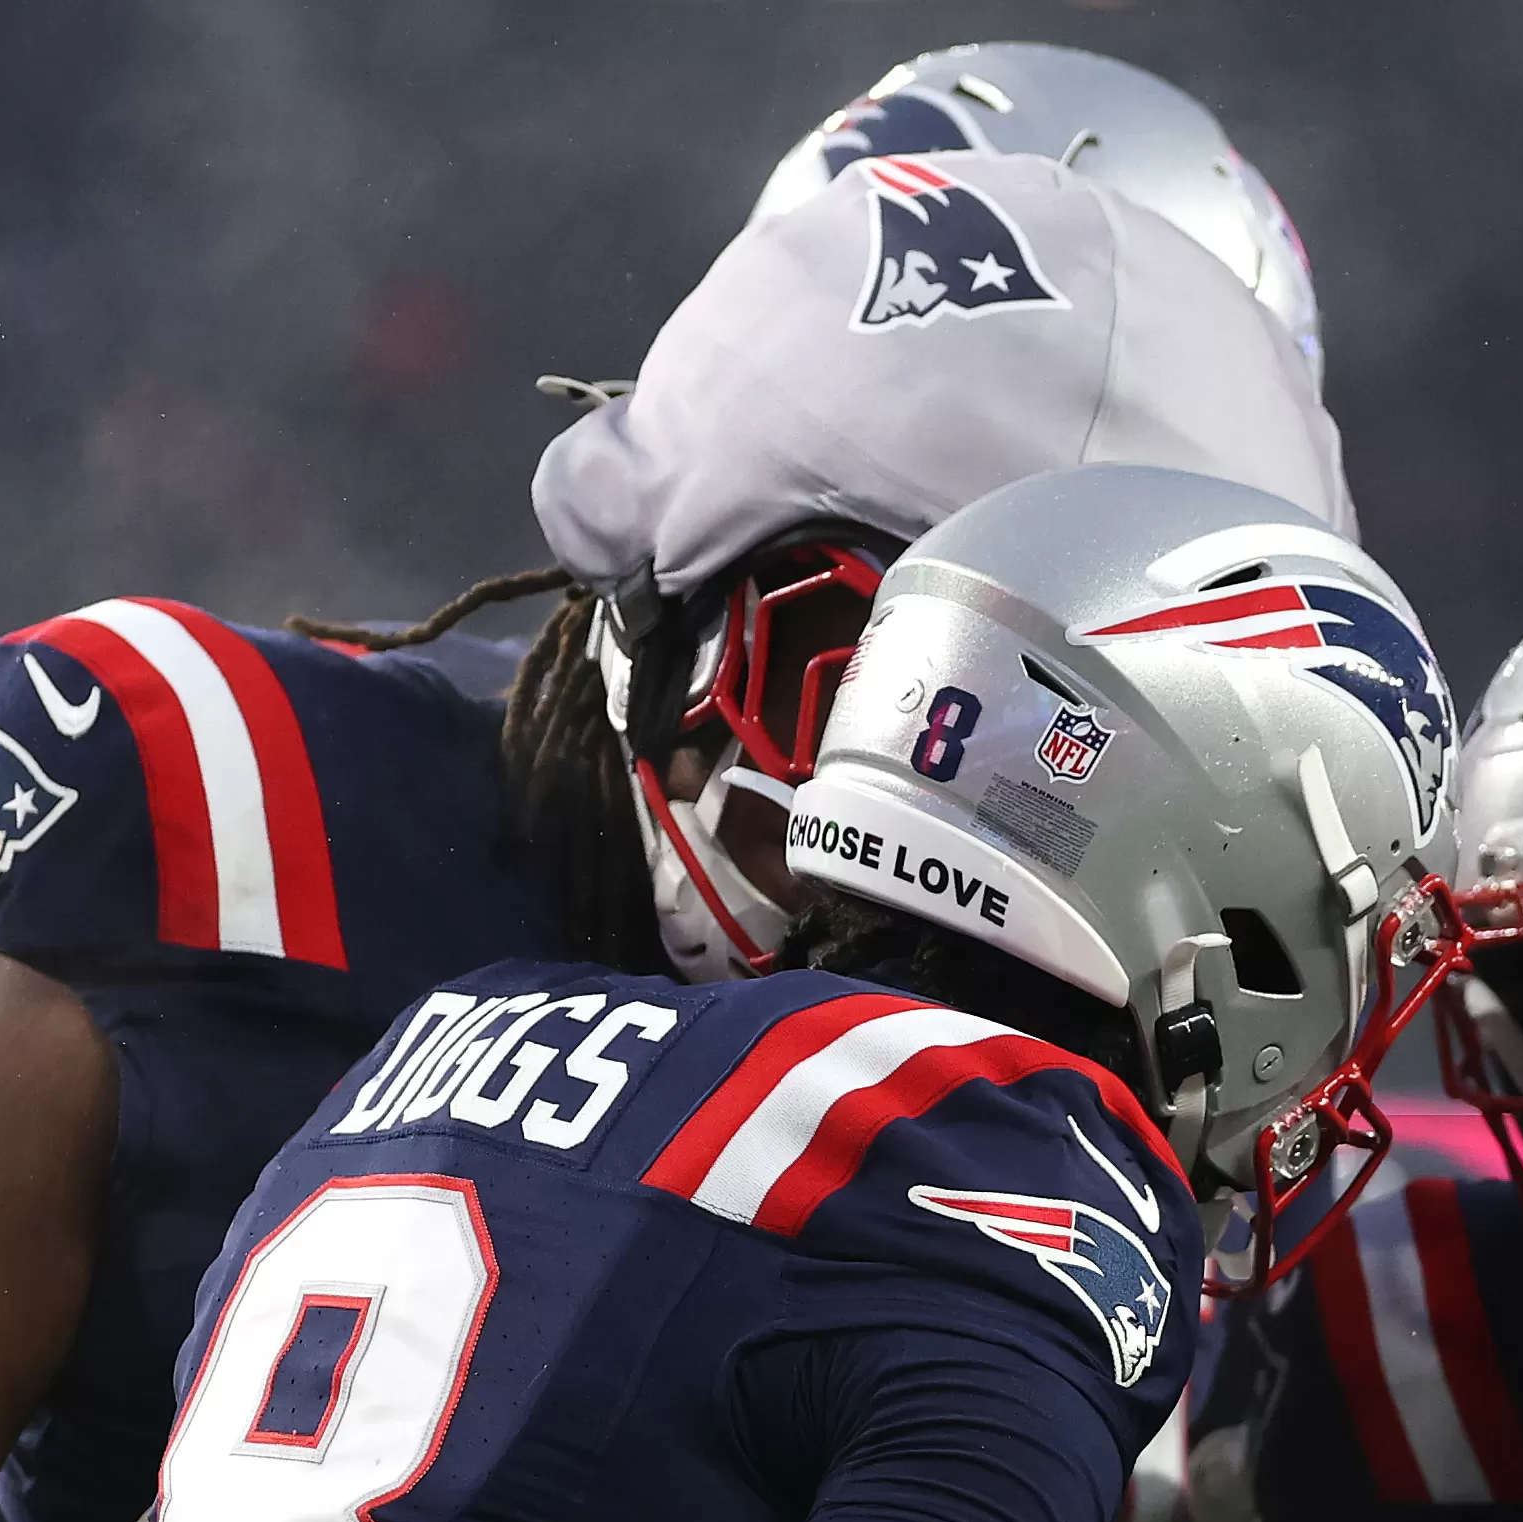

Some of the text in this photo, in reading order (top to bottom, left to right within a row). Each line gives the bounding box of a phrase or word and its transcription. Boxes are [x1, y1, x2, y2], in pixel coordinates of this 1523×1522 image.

[910, 686, 982, 782] 8
[1043, 731, 1089, 774] NFL
[1020, 780, 1075, 811] WARNING
[789, 814, 884, 870] CHOOSE
[893, 845, 1010, 928] LOVE
[330, 991, 678, 1150] DIGGS
